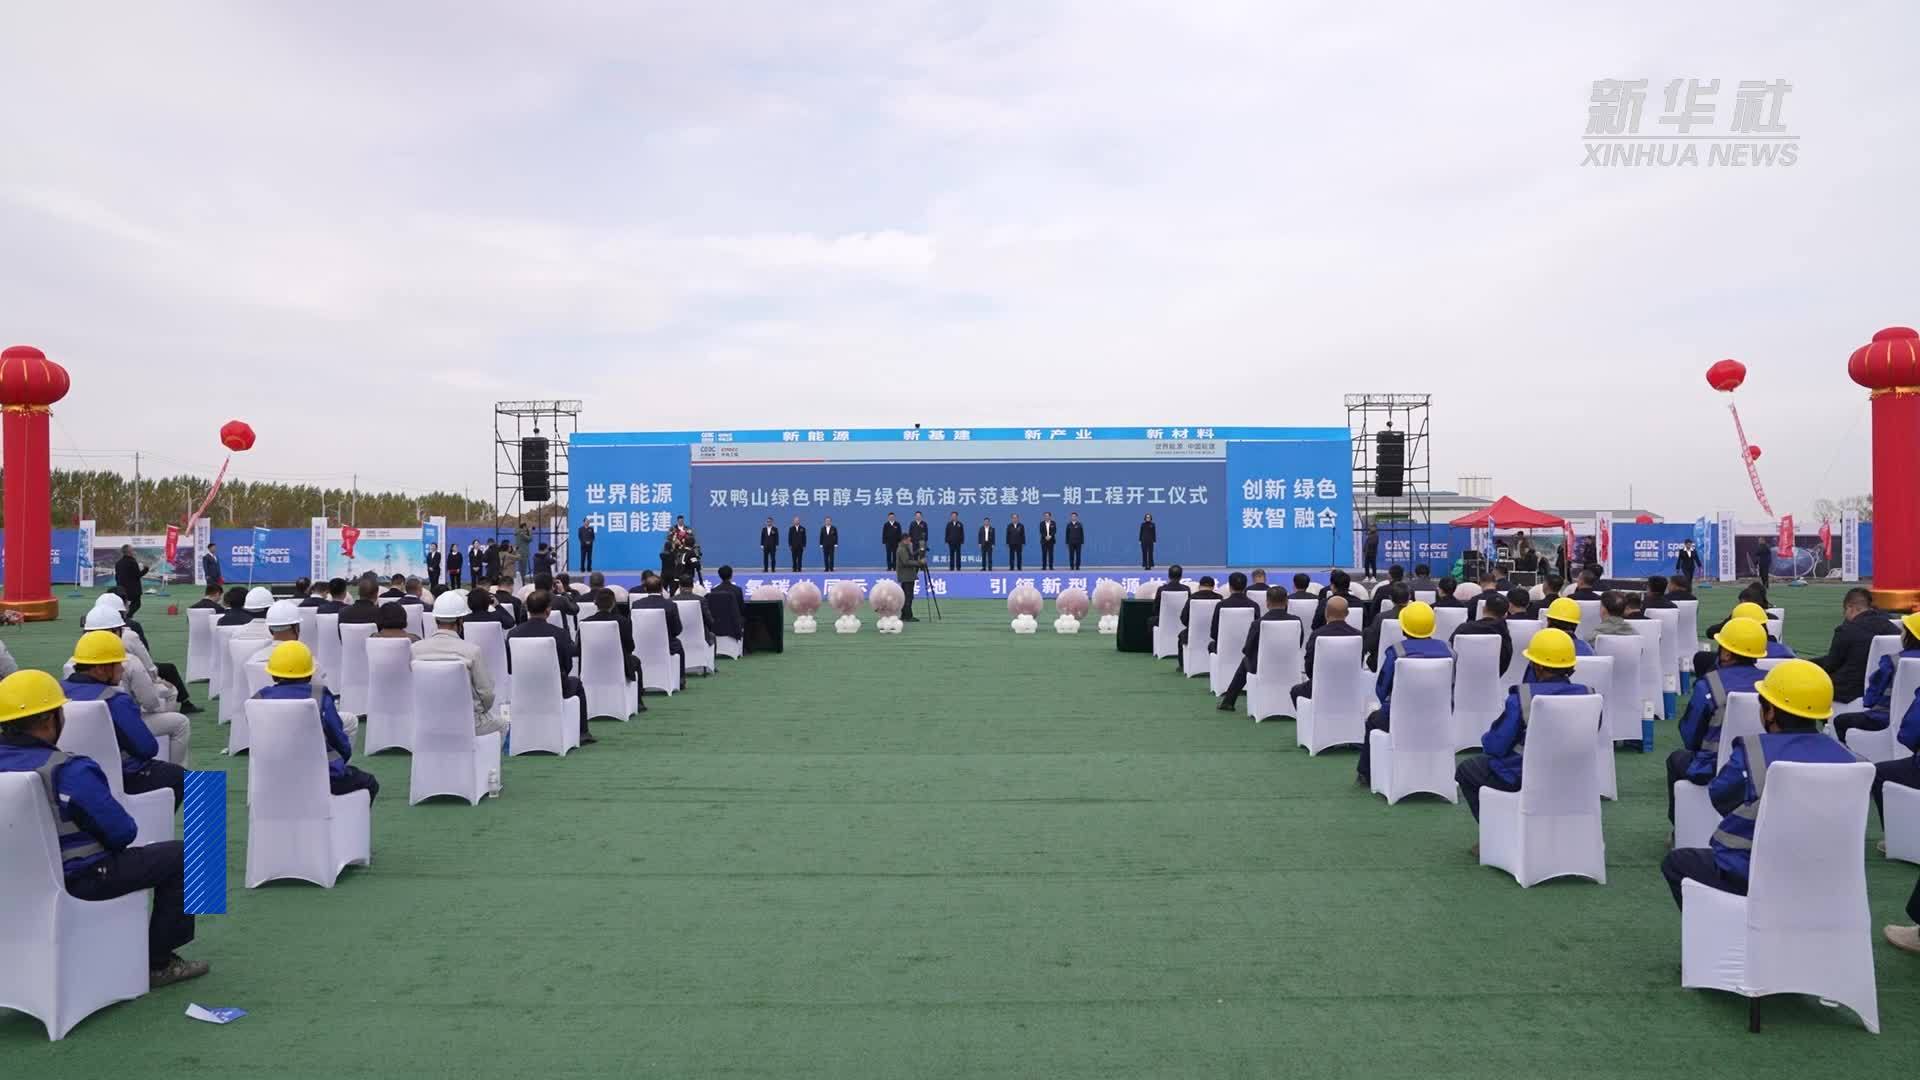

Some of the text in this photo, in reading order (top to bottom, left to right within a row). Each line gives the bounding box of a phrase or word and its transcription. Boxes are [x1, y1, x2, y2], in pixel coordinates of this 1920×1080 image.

[782, 428, 1215, 442] 新能源 新基建 新产业 新材料
[586, 483, 672, 505] 世界能源
[709, 485, 1208, 507] 双鸭山绿色甲醇与绿色航油示范基地一期工程开工仪式
[1242, 478, 1338, 500] 创新 绿色
[587, 512, 672, 533] 中国能建
[1242, 507, 1338, 528] 数智 融合
